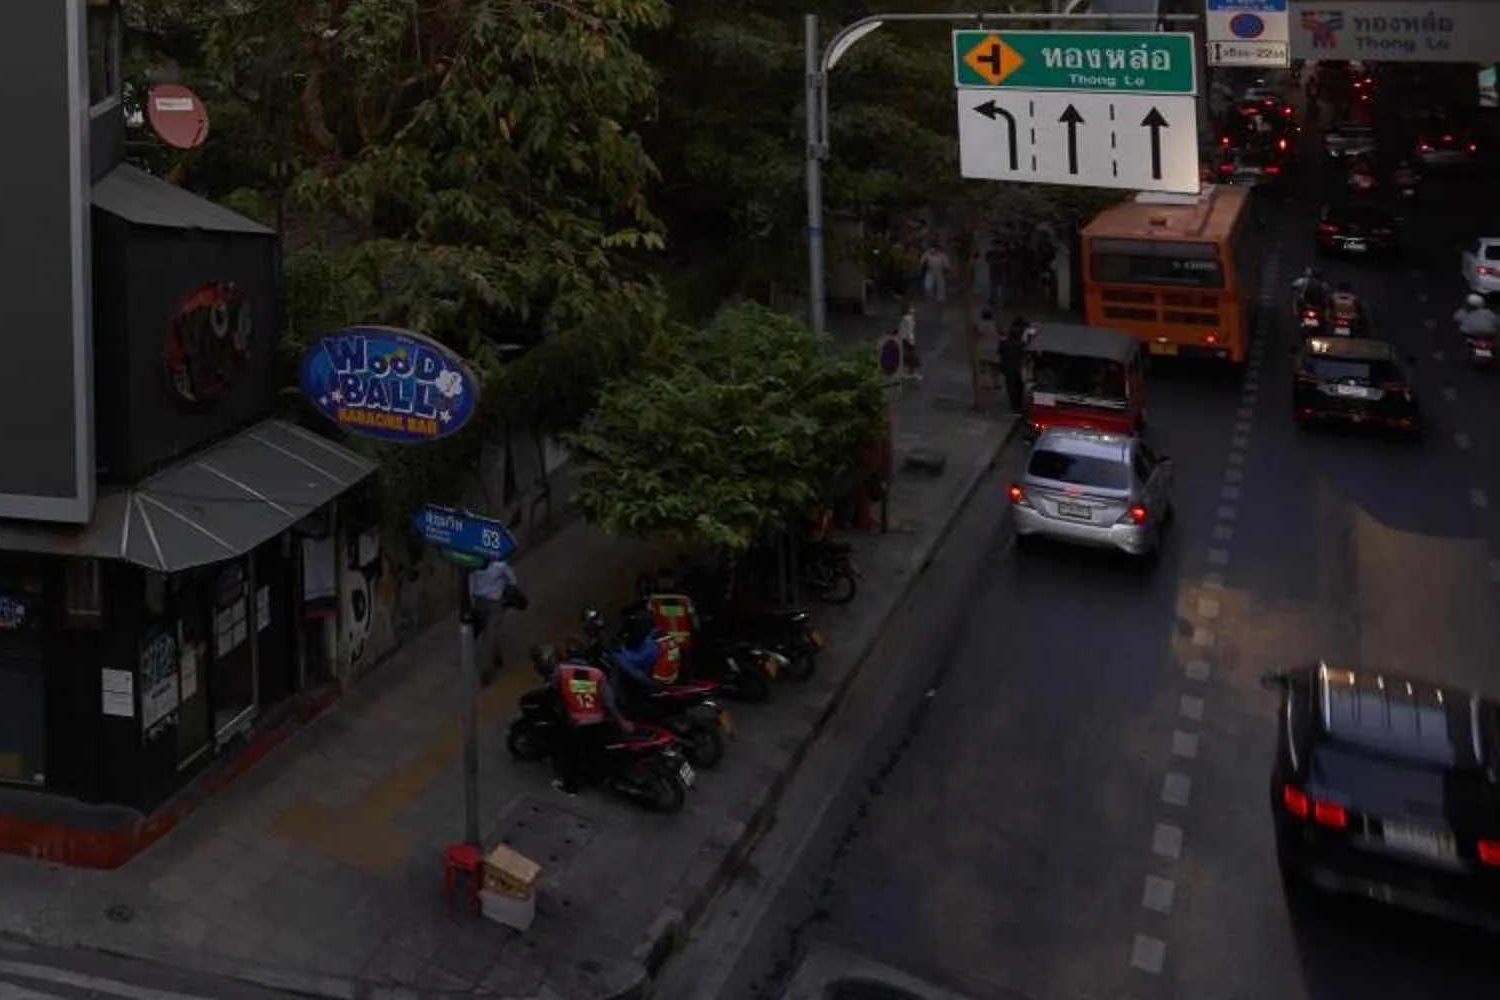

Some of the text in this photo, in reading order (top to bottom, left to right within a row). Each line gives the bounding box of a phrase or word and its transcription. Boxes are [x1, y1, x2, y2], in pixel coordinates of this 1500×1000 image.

[1353, 11, 1453, 32] ทองหล่อ
[1355, 36, 1450, 51] Thong Lo
[1042, 42, 1172, 71] ทองหล่อ
[1068, 73, 1145, 88] Thong Lo
[338, 370, 437, 419] BALL
